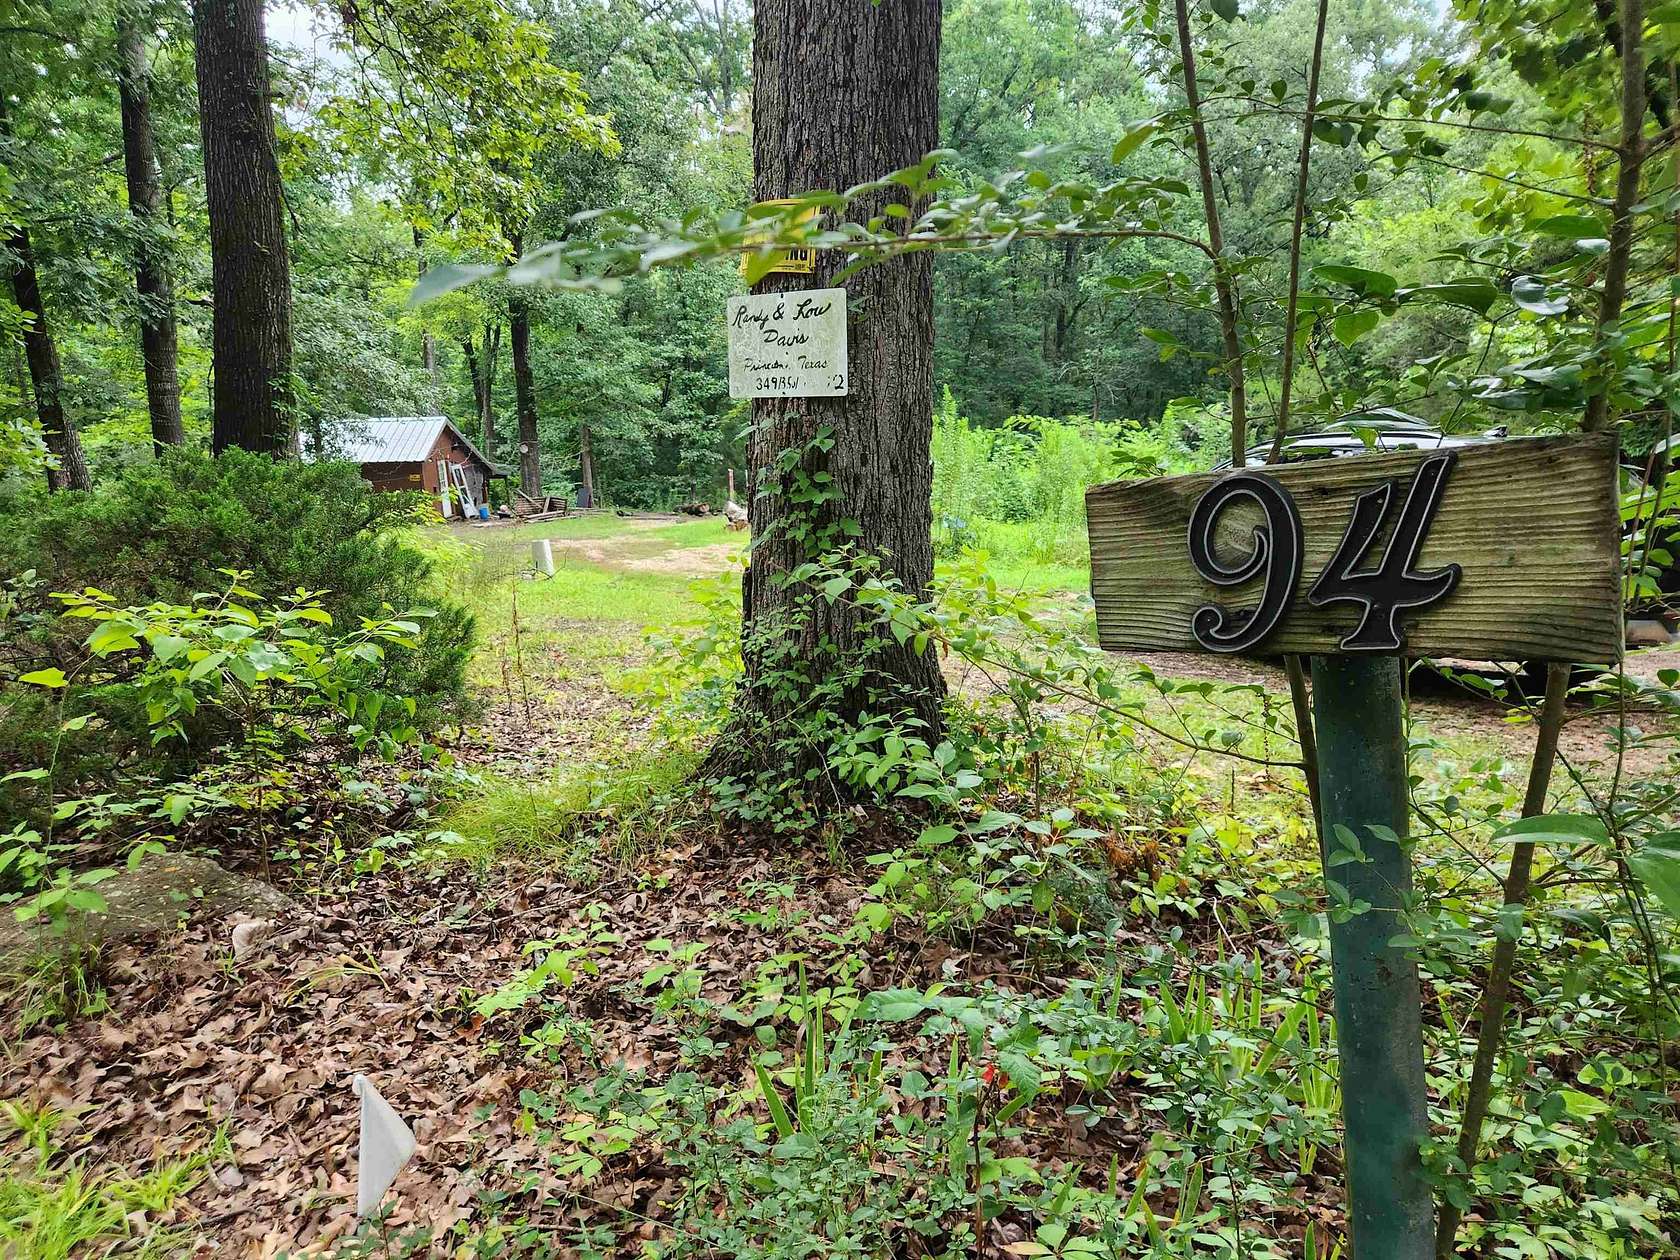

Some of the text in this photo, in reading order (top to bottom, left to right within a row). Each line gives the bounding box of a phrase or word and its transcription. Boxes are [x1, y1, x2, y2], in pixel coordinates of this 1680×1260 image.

[732, 305, 769, 330] Randy
[772, 302, 785, 320] &
[763, 329, 809, 347] Davis
[797, 355, 829, 369] Texas
[1186, 450, 1462, 653] 94
